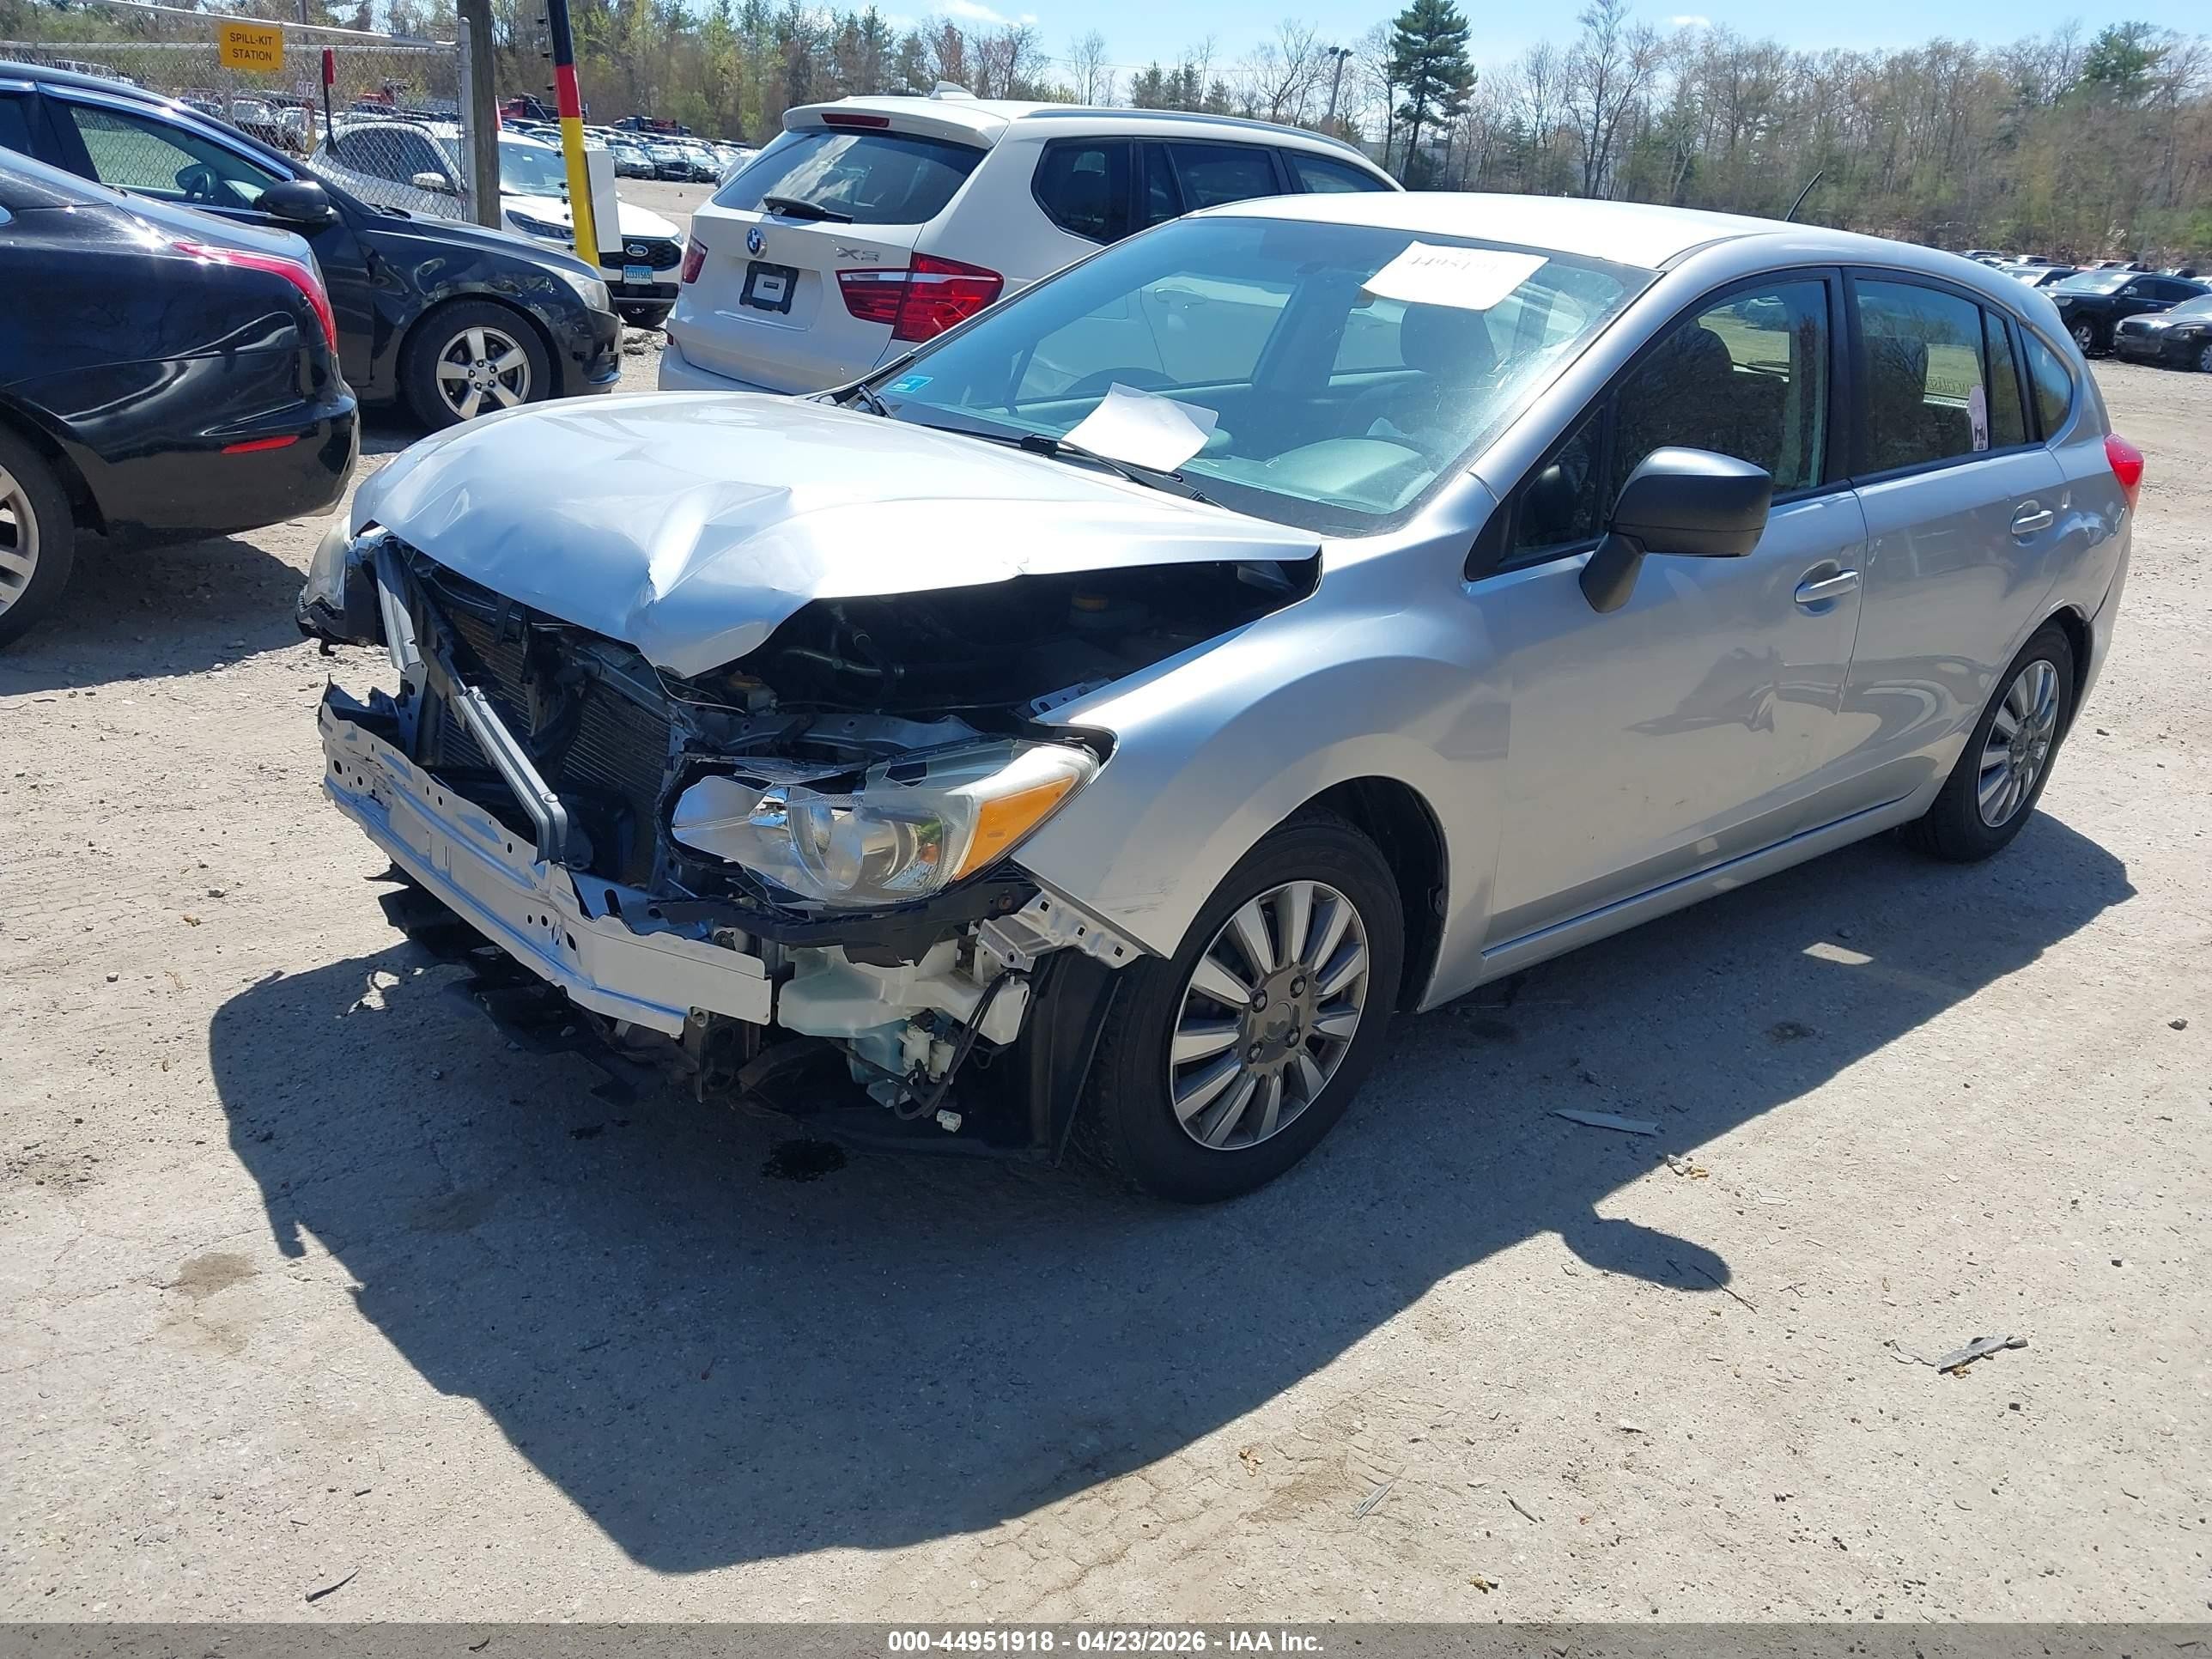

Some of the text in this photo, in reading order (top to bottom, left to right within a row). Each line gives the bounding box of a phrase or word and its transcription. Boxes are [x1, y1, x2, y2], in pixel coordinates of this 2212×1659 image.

[229, 32, 273, 46] SPILL-KIT
[232, 48, 272, 62] STATION
[835, 246, 881, 262] X3
